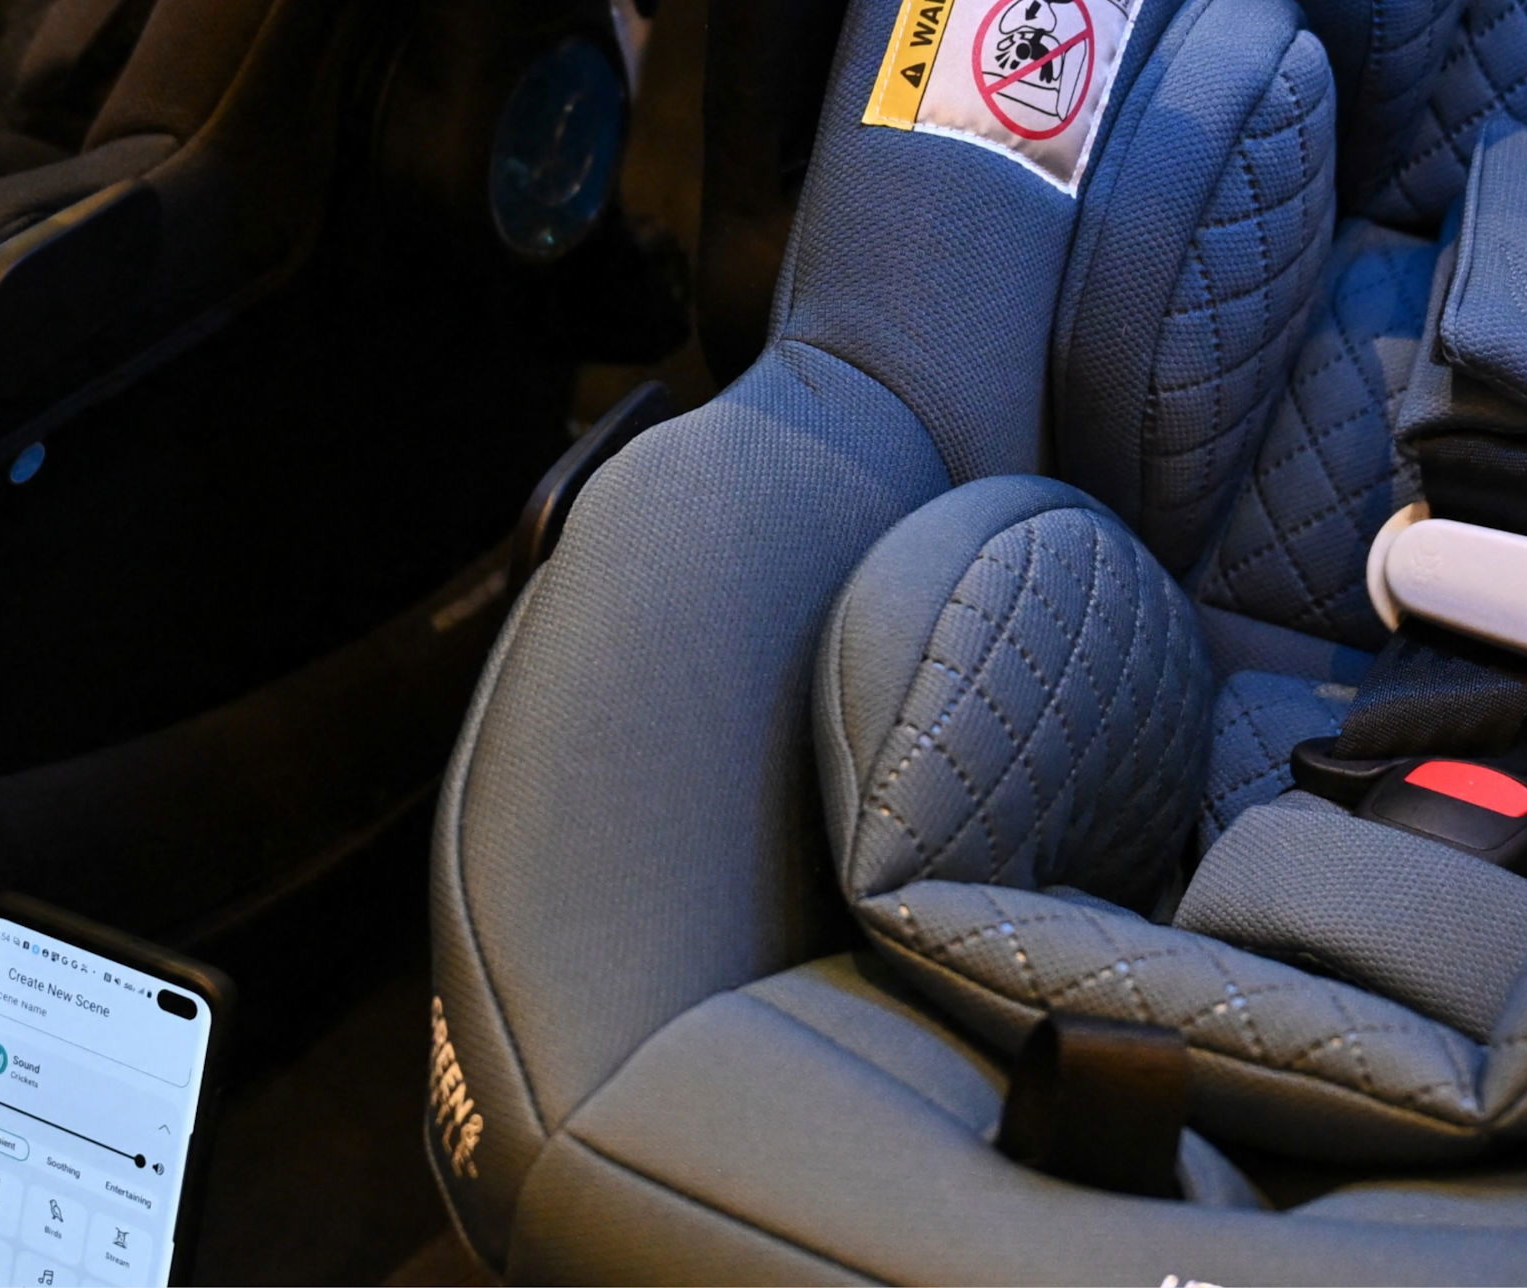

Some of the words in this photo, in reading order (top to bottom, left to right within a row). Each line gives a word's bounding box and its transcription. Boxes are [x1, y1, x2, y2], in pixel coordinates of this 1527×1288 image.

[8, 967, 45, 992] Create
[47, 983, 73, 1003] New
[75, 994, 110, 1018] Scene
[10, 1069, 39, 1089] Crickets
[12, 1054, 41, 1075] Sound
[46, 1155, 81, 1180] Soothing
[104, 1180, 153, 1210] Entertaining
[43, 1225, 63, 1240] Birds
[105, 1251, 131, 1269] Stream
